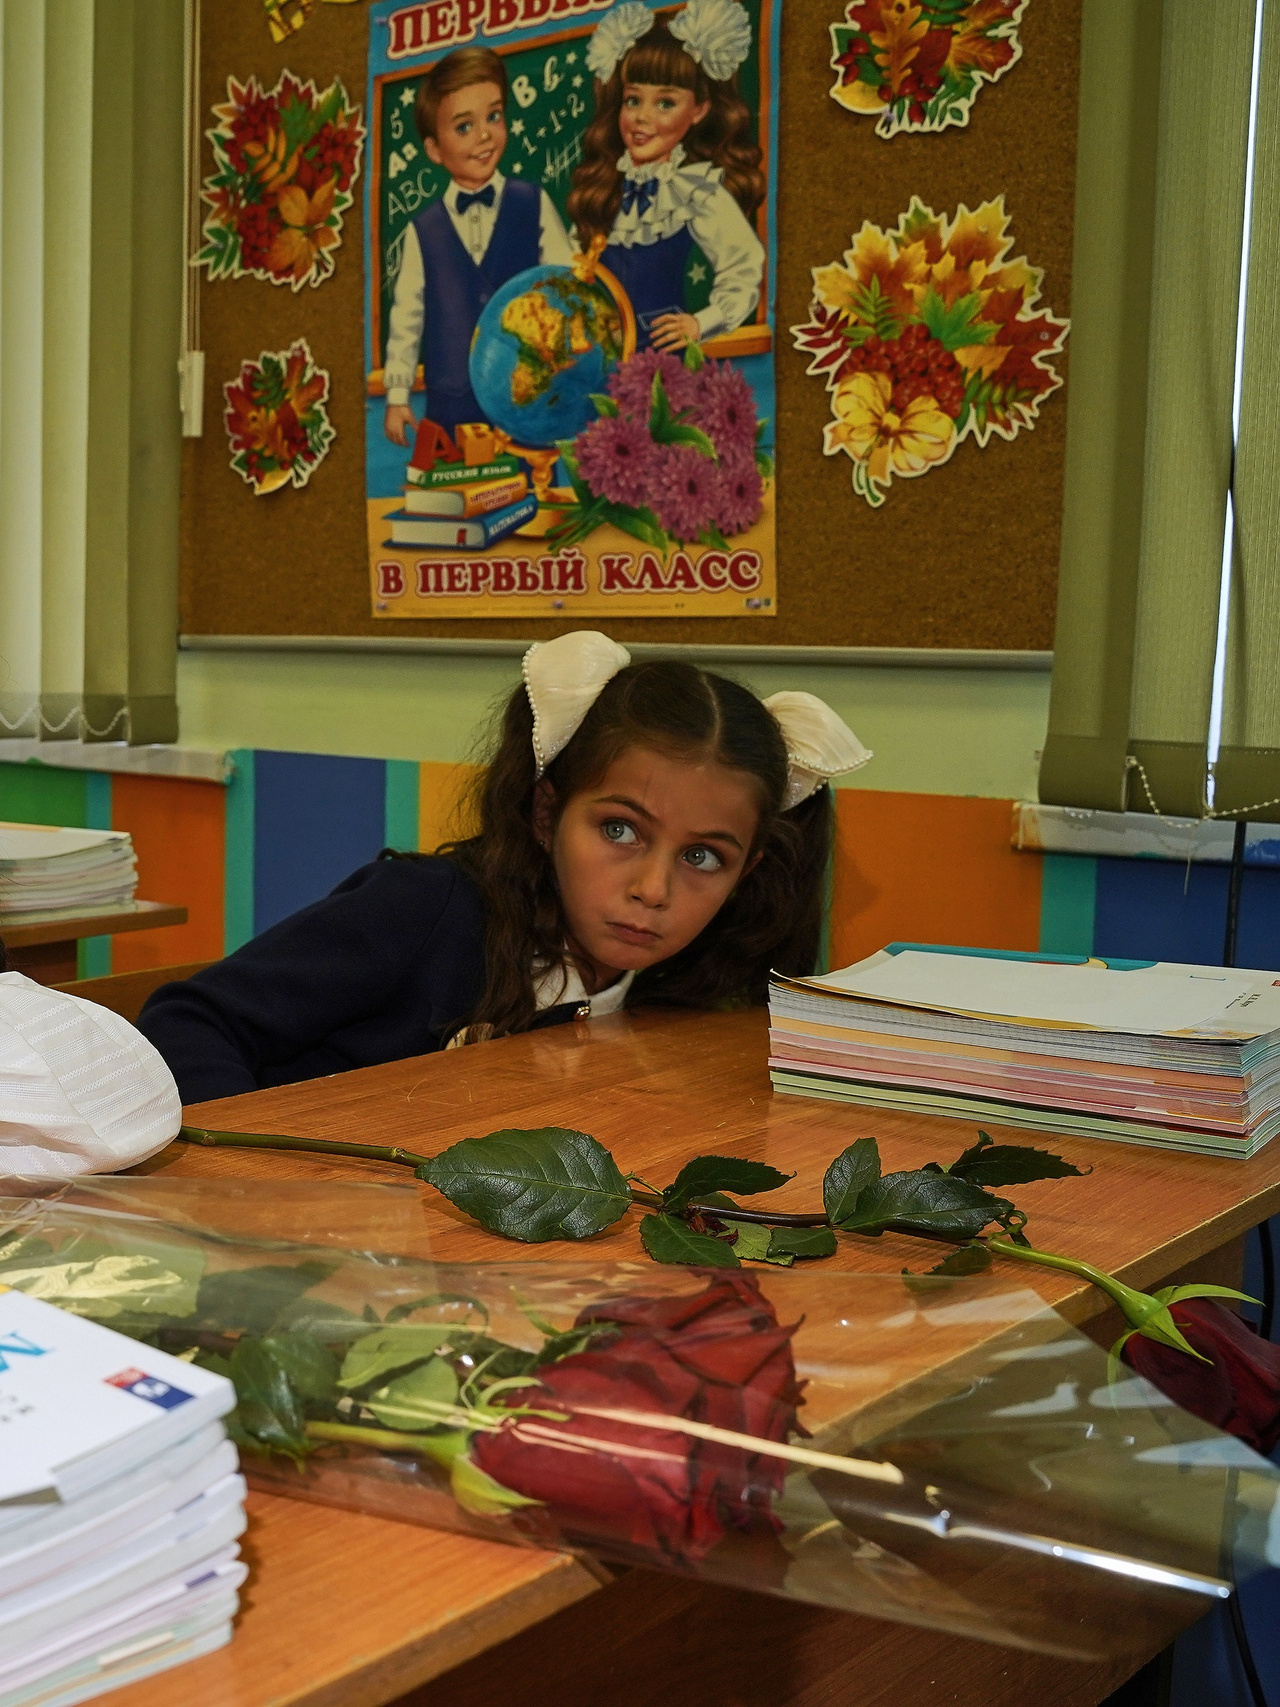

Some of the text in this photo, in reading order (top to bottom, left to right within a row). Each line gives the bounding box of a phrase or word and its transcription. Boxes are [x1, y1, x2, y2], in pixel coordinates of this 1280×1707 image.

[390, 0, 613, 55] ПЕРВЫ
[389, 107, 405, 140] 5
[378, 548, 761, 597] В ПЕРВЫЙ КЛАСС
